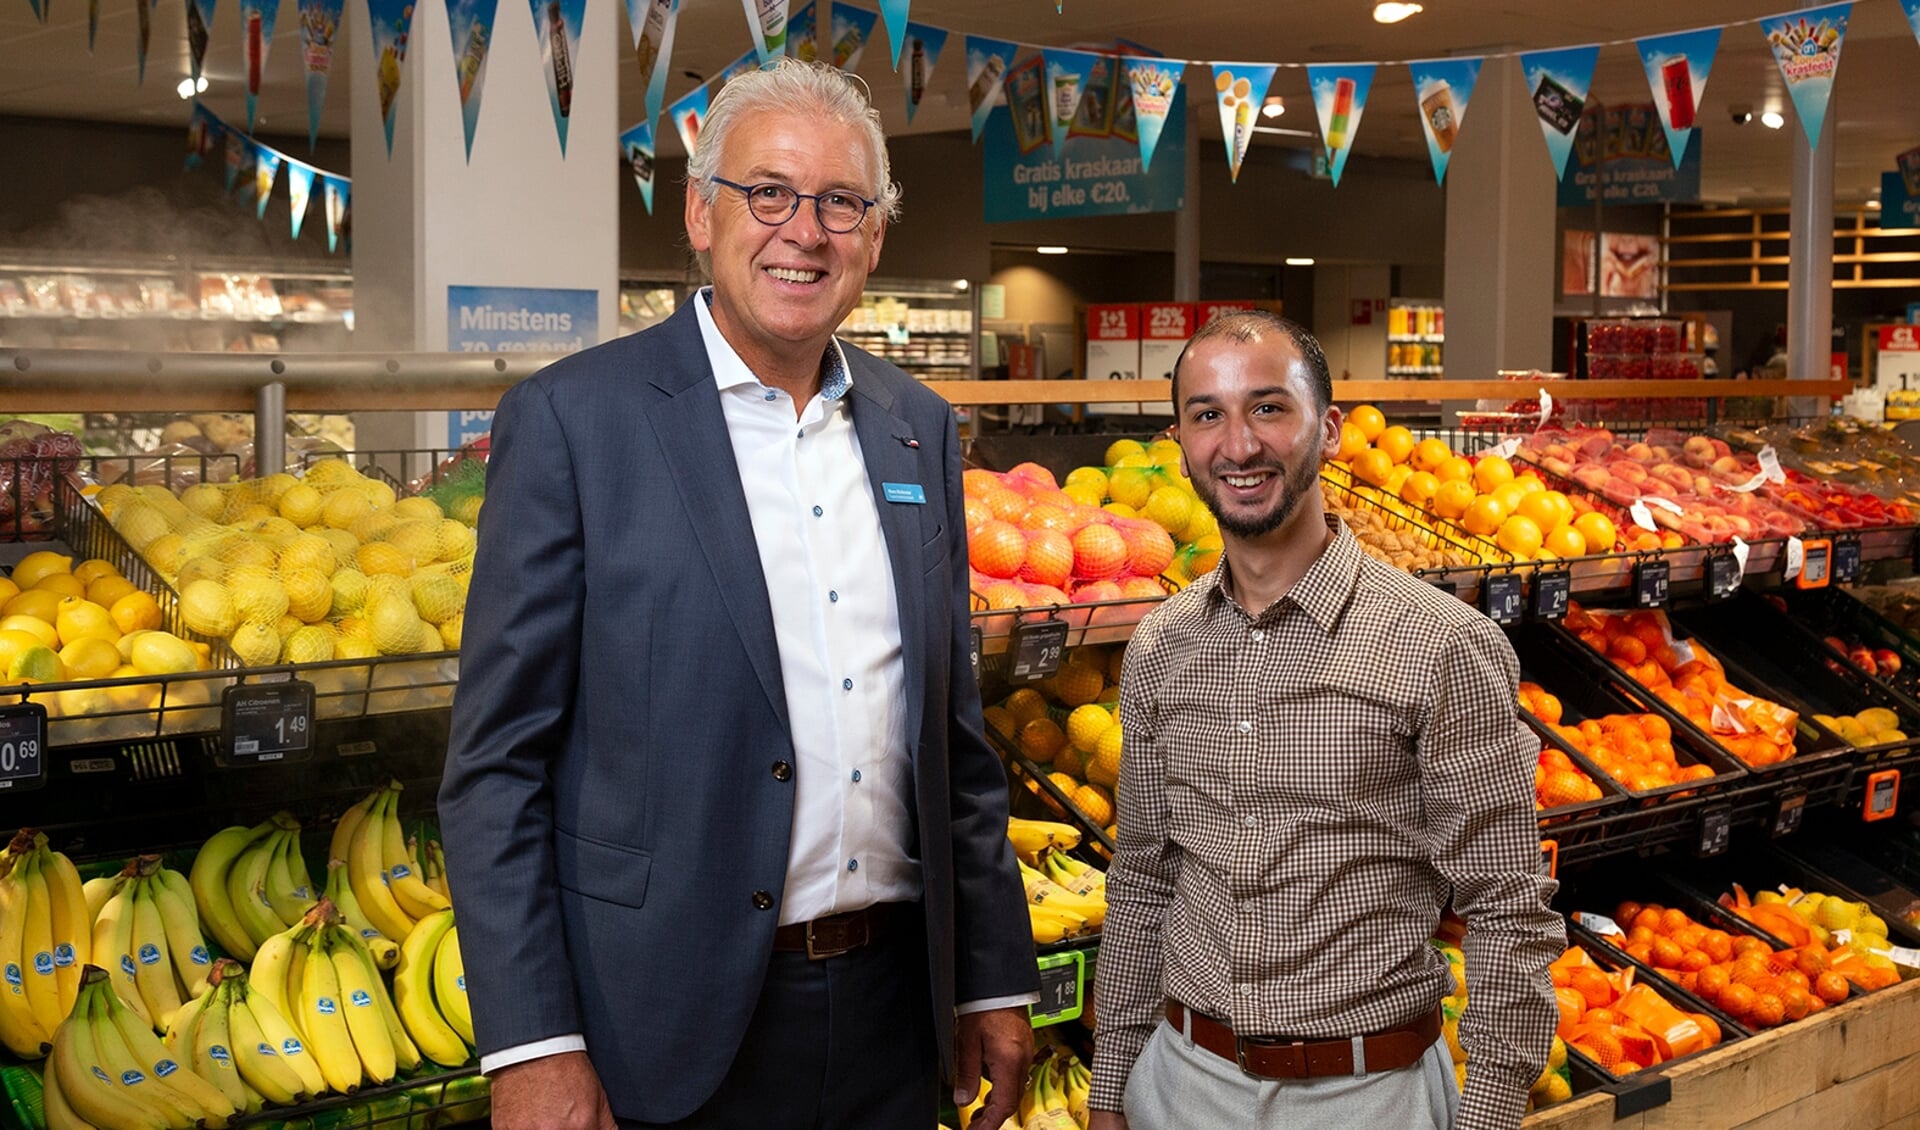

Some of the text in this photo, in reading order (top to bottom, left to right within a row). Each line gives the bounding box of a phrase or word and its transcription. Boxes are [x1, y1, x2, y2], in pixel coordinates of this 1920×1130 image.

[1013, 154, 1140, 184] Gratis kraskaar
[1028, 180, 1131, 212] bij elke €20.
[460, 305, 572, 332] Minstens
[1099, 310, 1128, 328] 1+1
[1150, 306, 1186, 327] 25%
